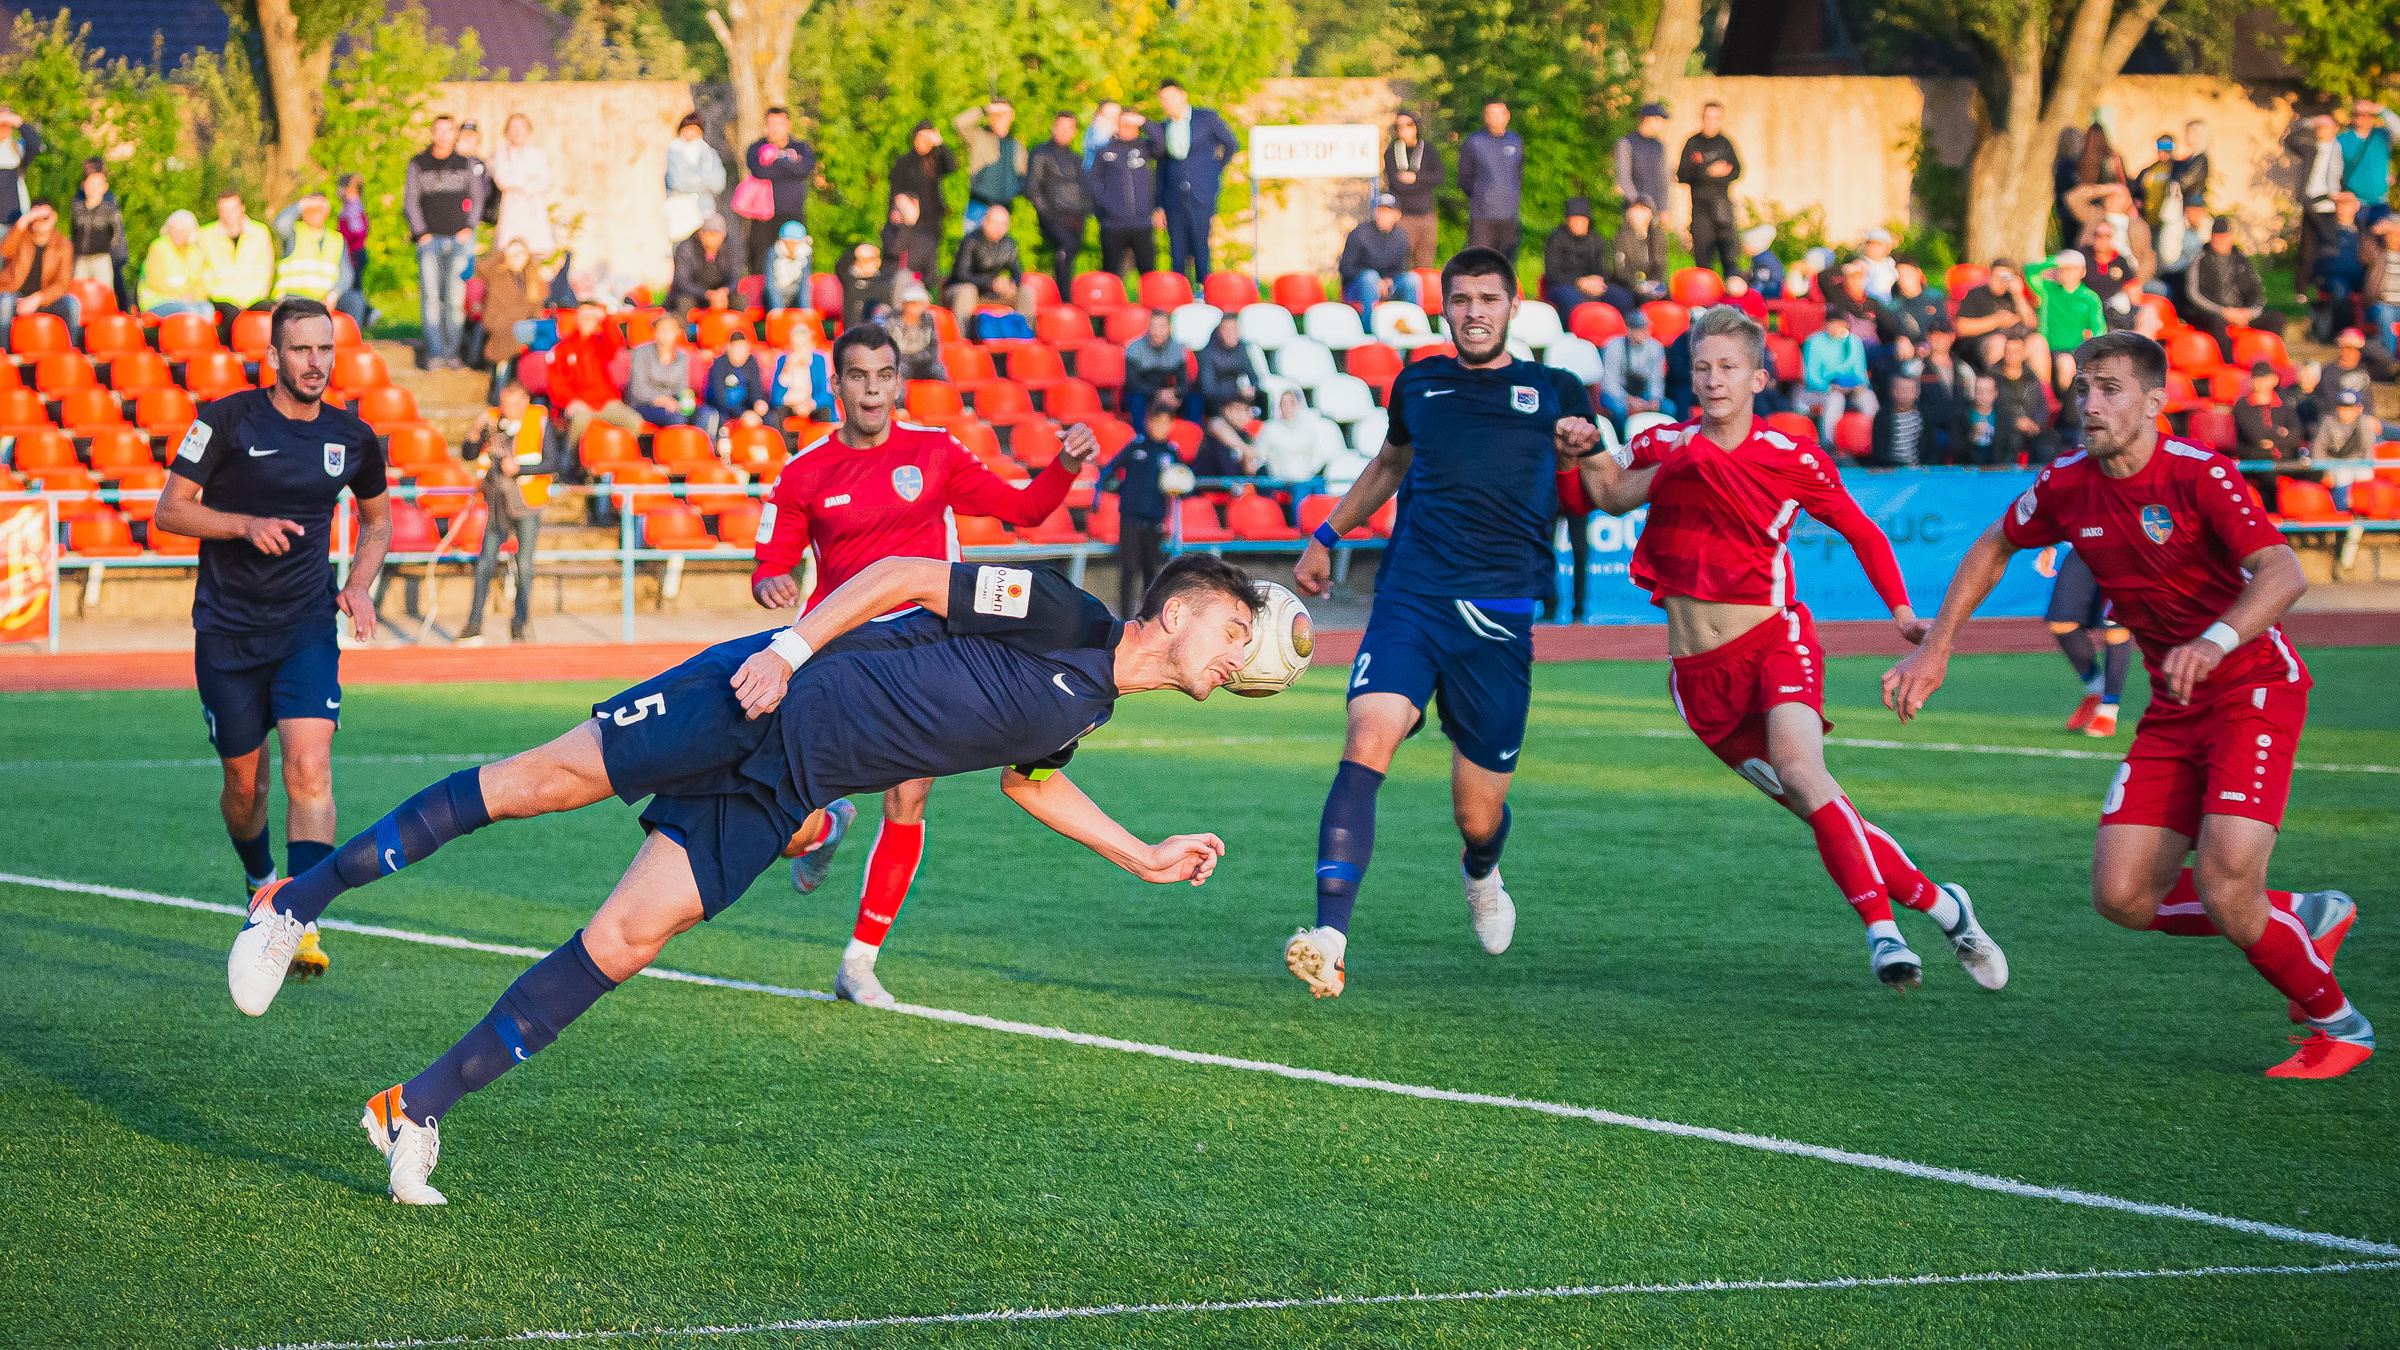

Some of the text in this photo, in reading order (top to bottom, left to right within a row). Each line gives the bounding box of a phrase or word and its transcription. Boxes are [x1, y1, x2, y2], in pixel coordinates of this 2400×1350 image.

[1263, 142, 1369, 160] СЕКТОР 14
[2080, 526, 2104, 538] JAKO
[993, 569, 1007, 612] ОЛИМП
[613, 692, 666, 727] 5
[2219, 790, 2247, 802] JAKO
